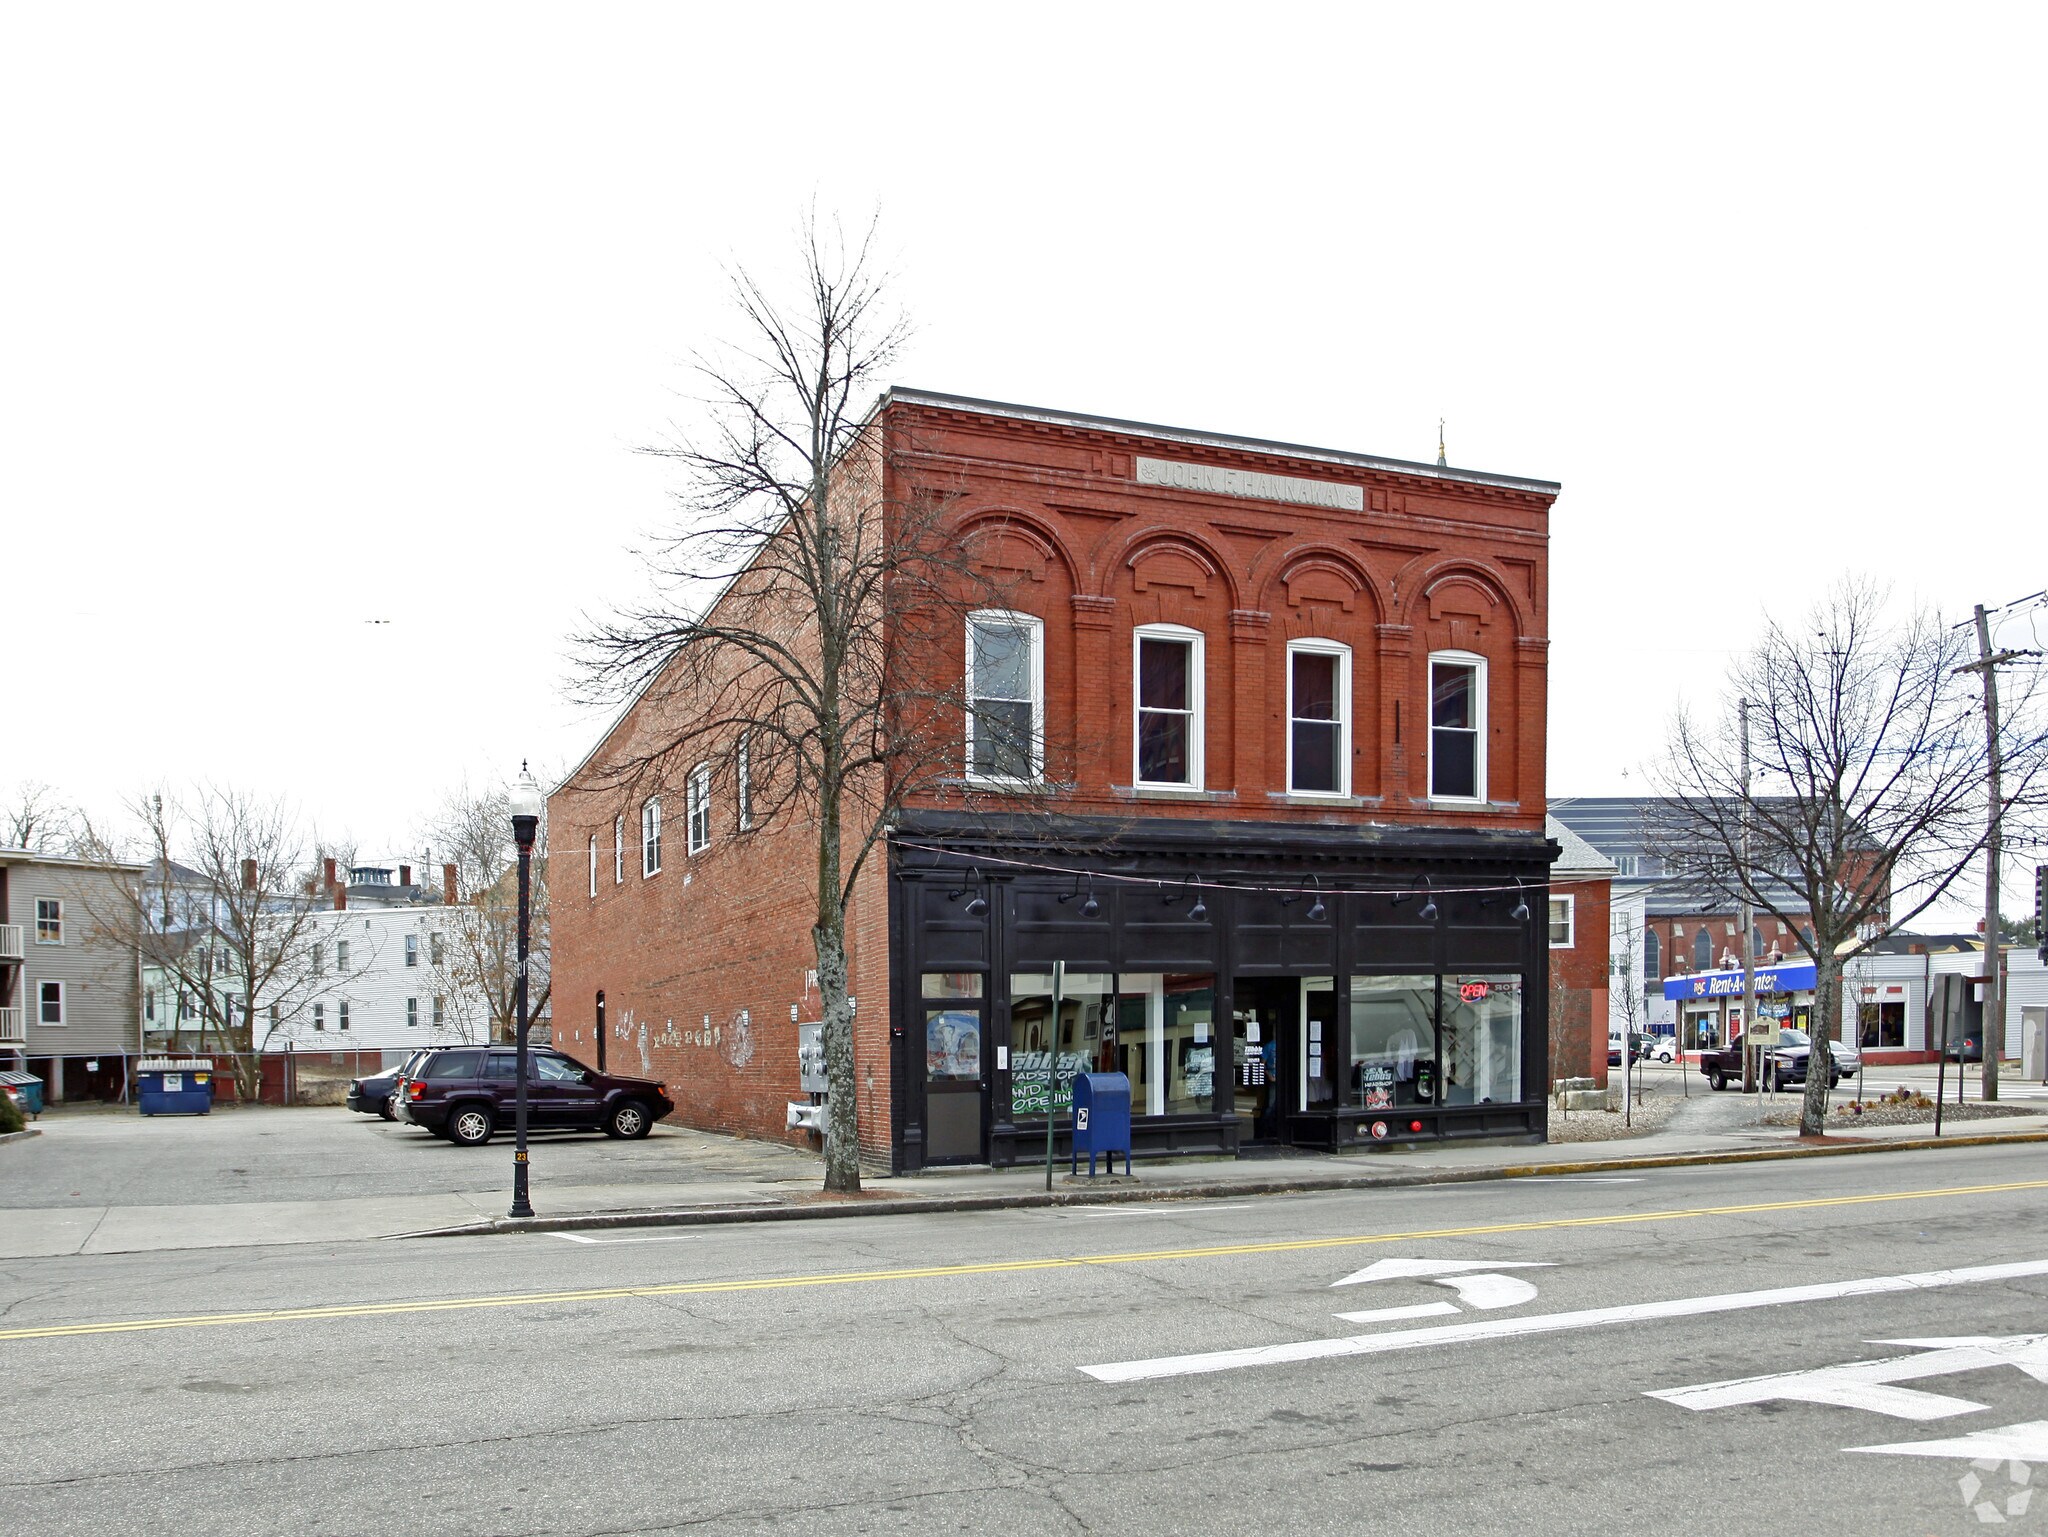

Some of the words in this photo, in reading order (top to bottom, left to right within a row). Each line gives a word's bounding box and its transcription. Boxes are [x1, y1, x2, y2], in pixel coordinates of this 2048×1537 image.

[1158, 461, 1216, 492] JOHN
[1243, 471, 1340, 508] HANNAWAY
[1460, 984, 1487, 997] OPEN
[516, 1153, 527, 1161] 23
